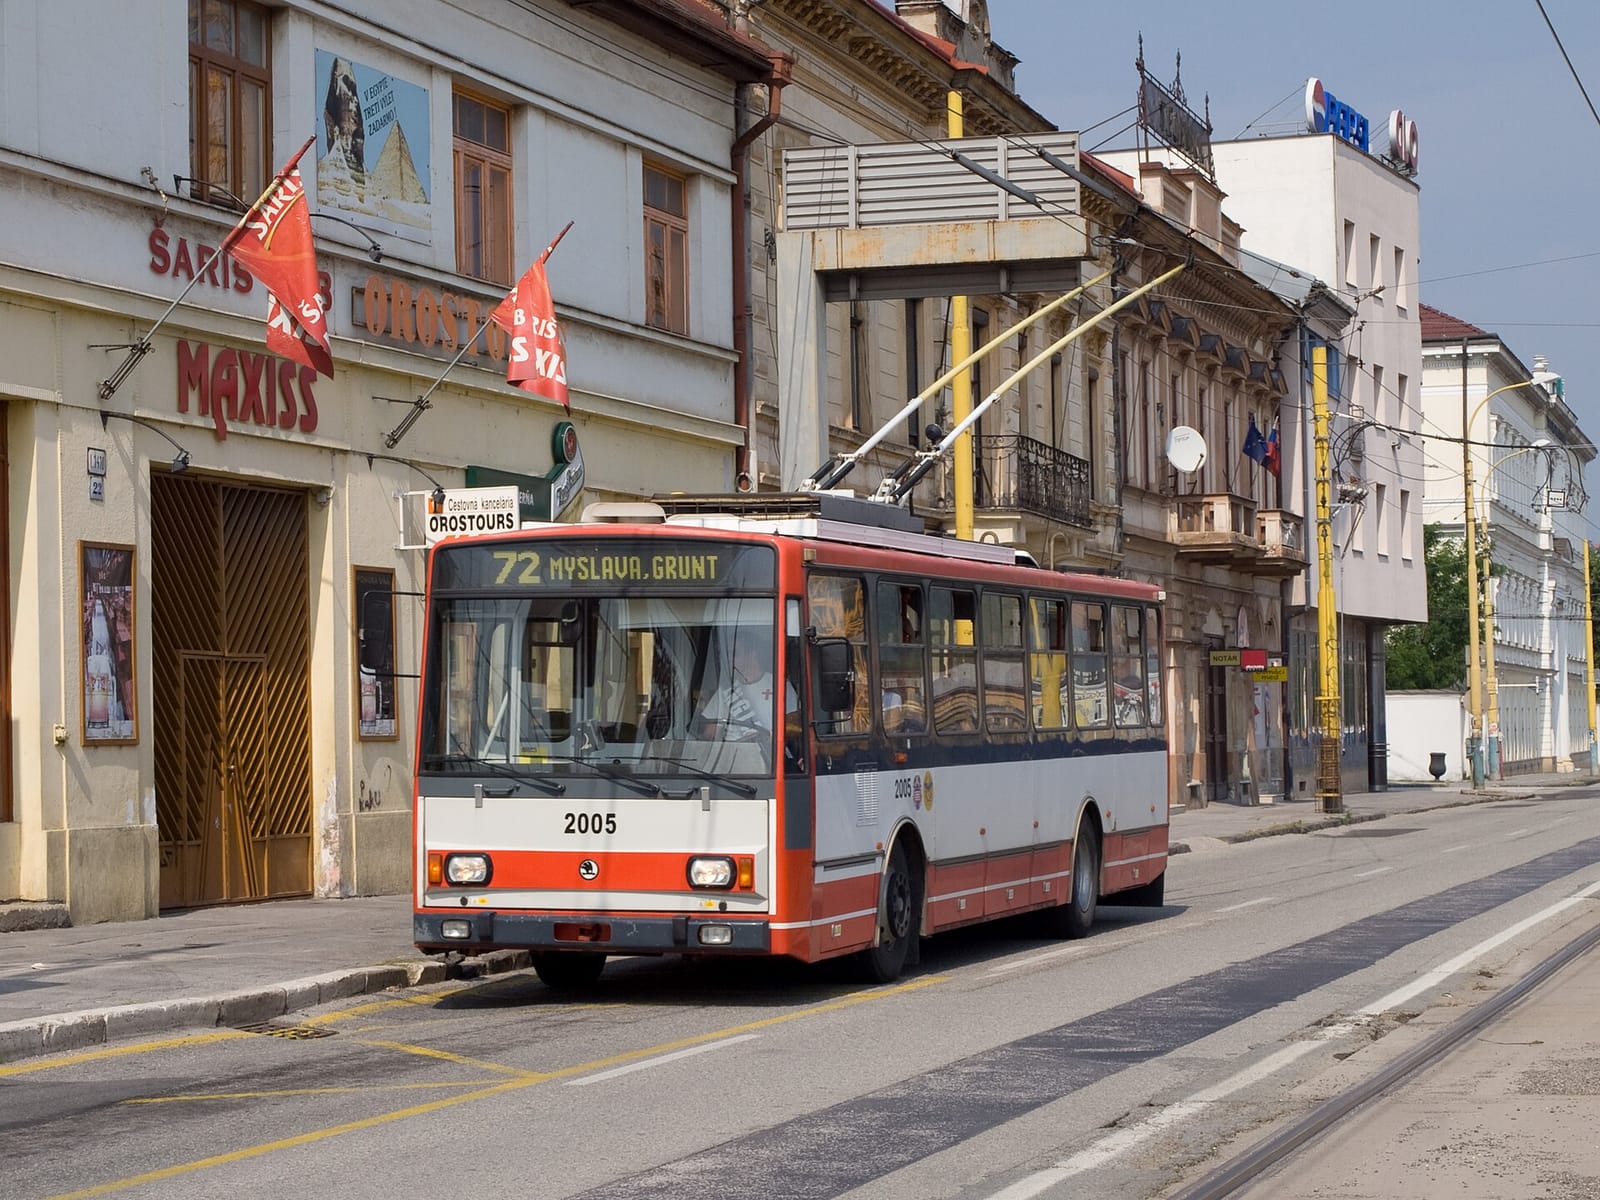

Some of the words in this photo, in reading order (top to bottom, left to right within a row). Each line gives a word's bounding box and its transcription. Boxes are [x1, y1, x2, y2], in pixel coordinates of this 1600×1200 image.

[363, 90, 371, 102] V
[177, 339, 319, 441] MAXISS
[448, 496, 479, 512] Cestovná
[481, 495, 514, 510] kancelária
[429, 512, 515, 533] OROSTOURS
[493, 551, 541, 584] 72
[895, 777, 912, 799] 2005
[563, 812, 617, 835] 2005
